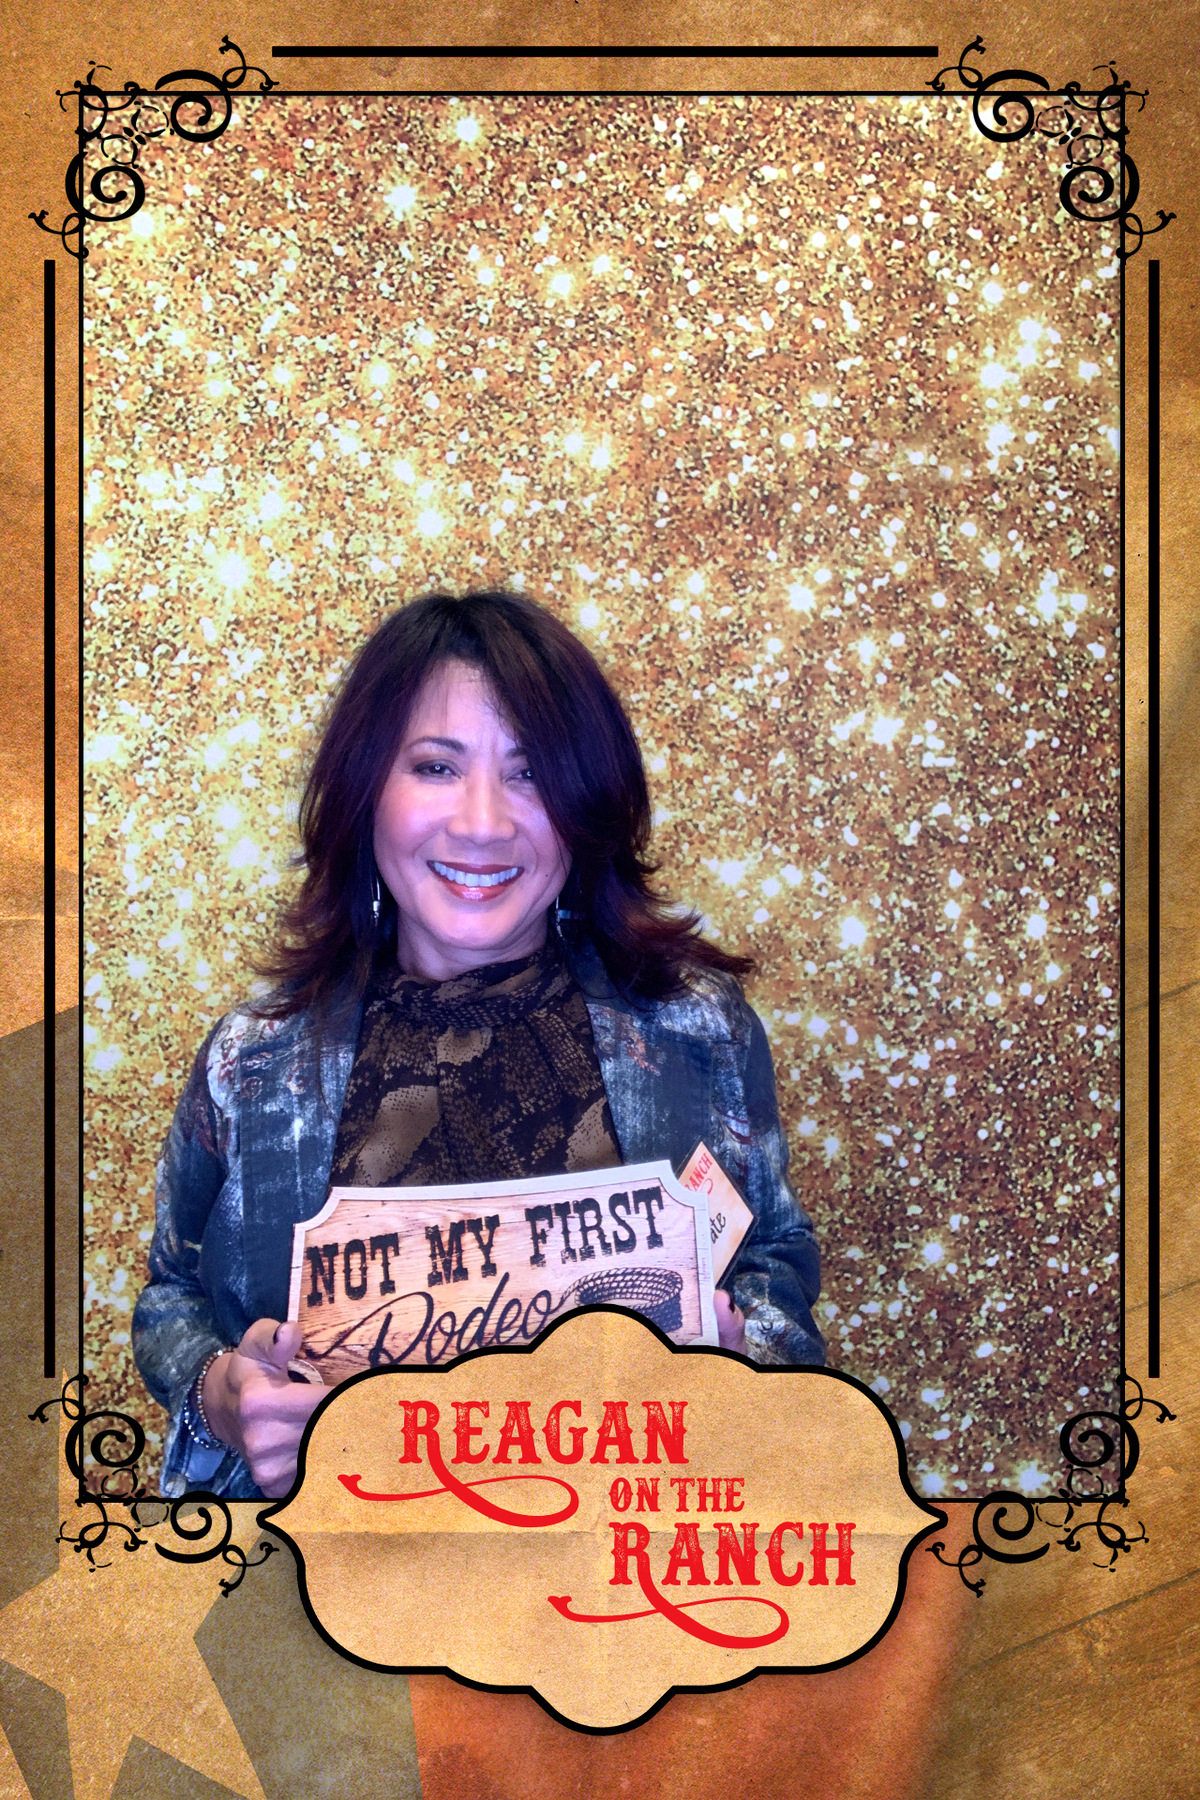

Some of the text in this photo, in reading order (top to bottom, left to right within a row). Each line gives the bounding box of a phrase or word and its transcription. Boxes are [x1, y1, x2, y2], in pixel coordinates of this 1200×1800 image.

[306, 1186, 665, 1308] NOT MY FIRST
[305, 1271, 568, 1368] Rodeo
